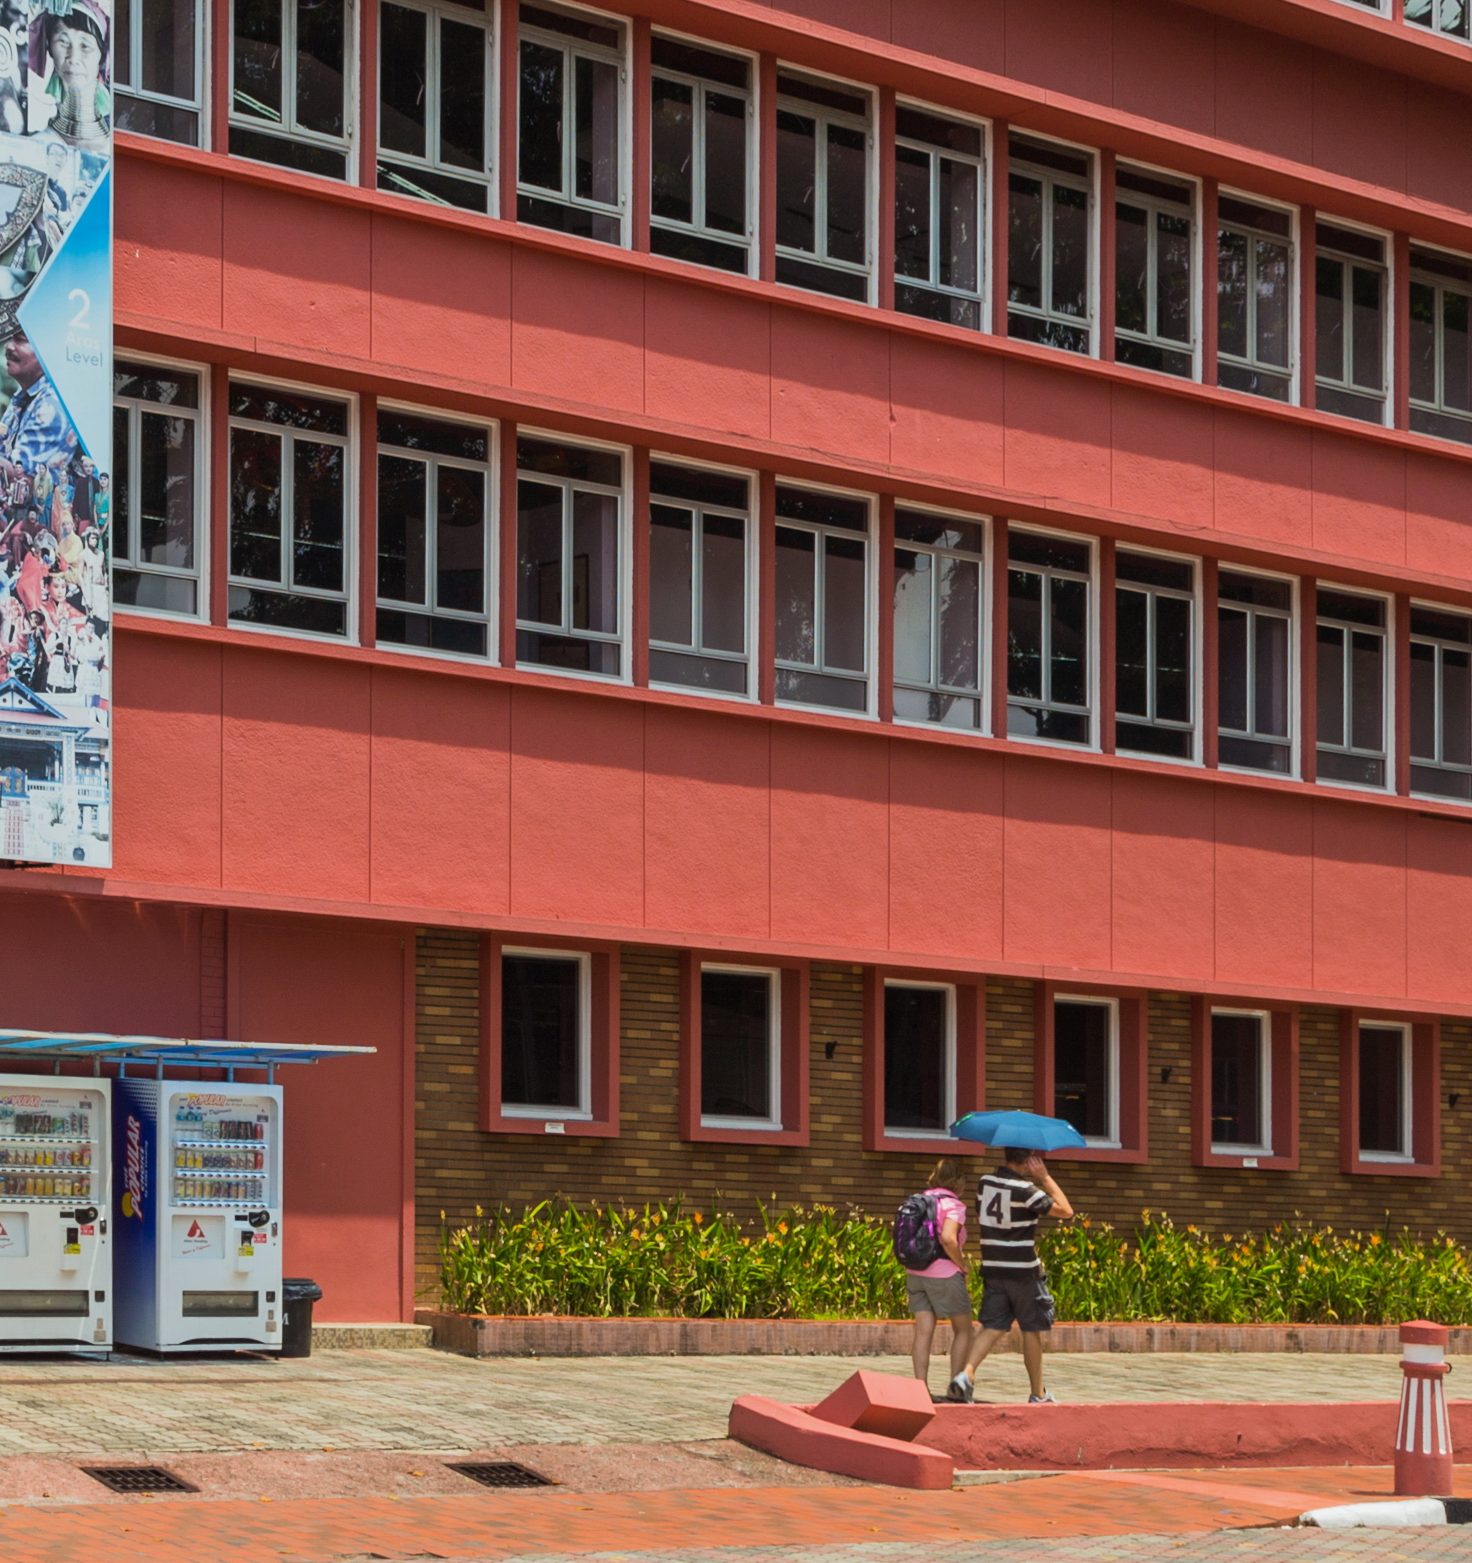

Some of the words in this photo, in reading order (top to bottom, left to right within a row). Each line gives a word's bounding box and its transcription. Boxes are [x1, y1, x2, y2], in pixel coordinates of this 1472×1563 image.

[68, 288, 91, 329] 2
[66, 346, 104, 367] Level
[187, 1093, 227, 1107] POPULAR
[126, 1114, 143, 1222] POPULAR
[986, 1192, 1003, 1224] 4
